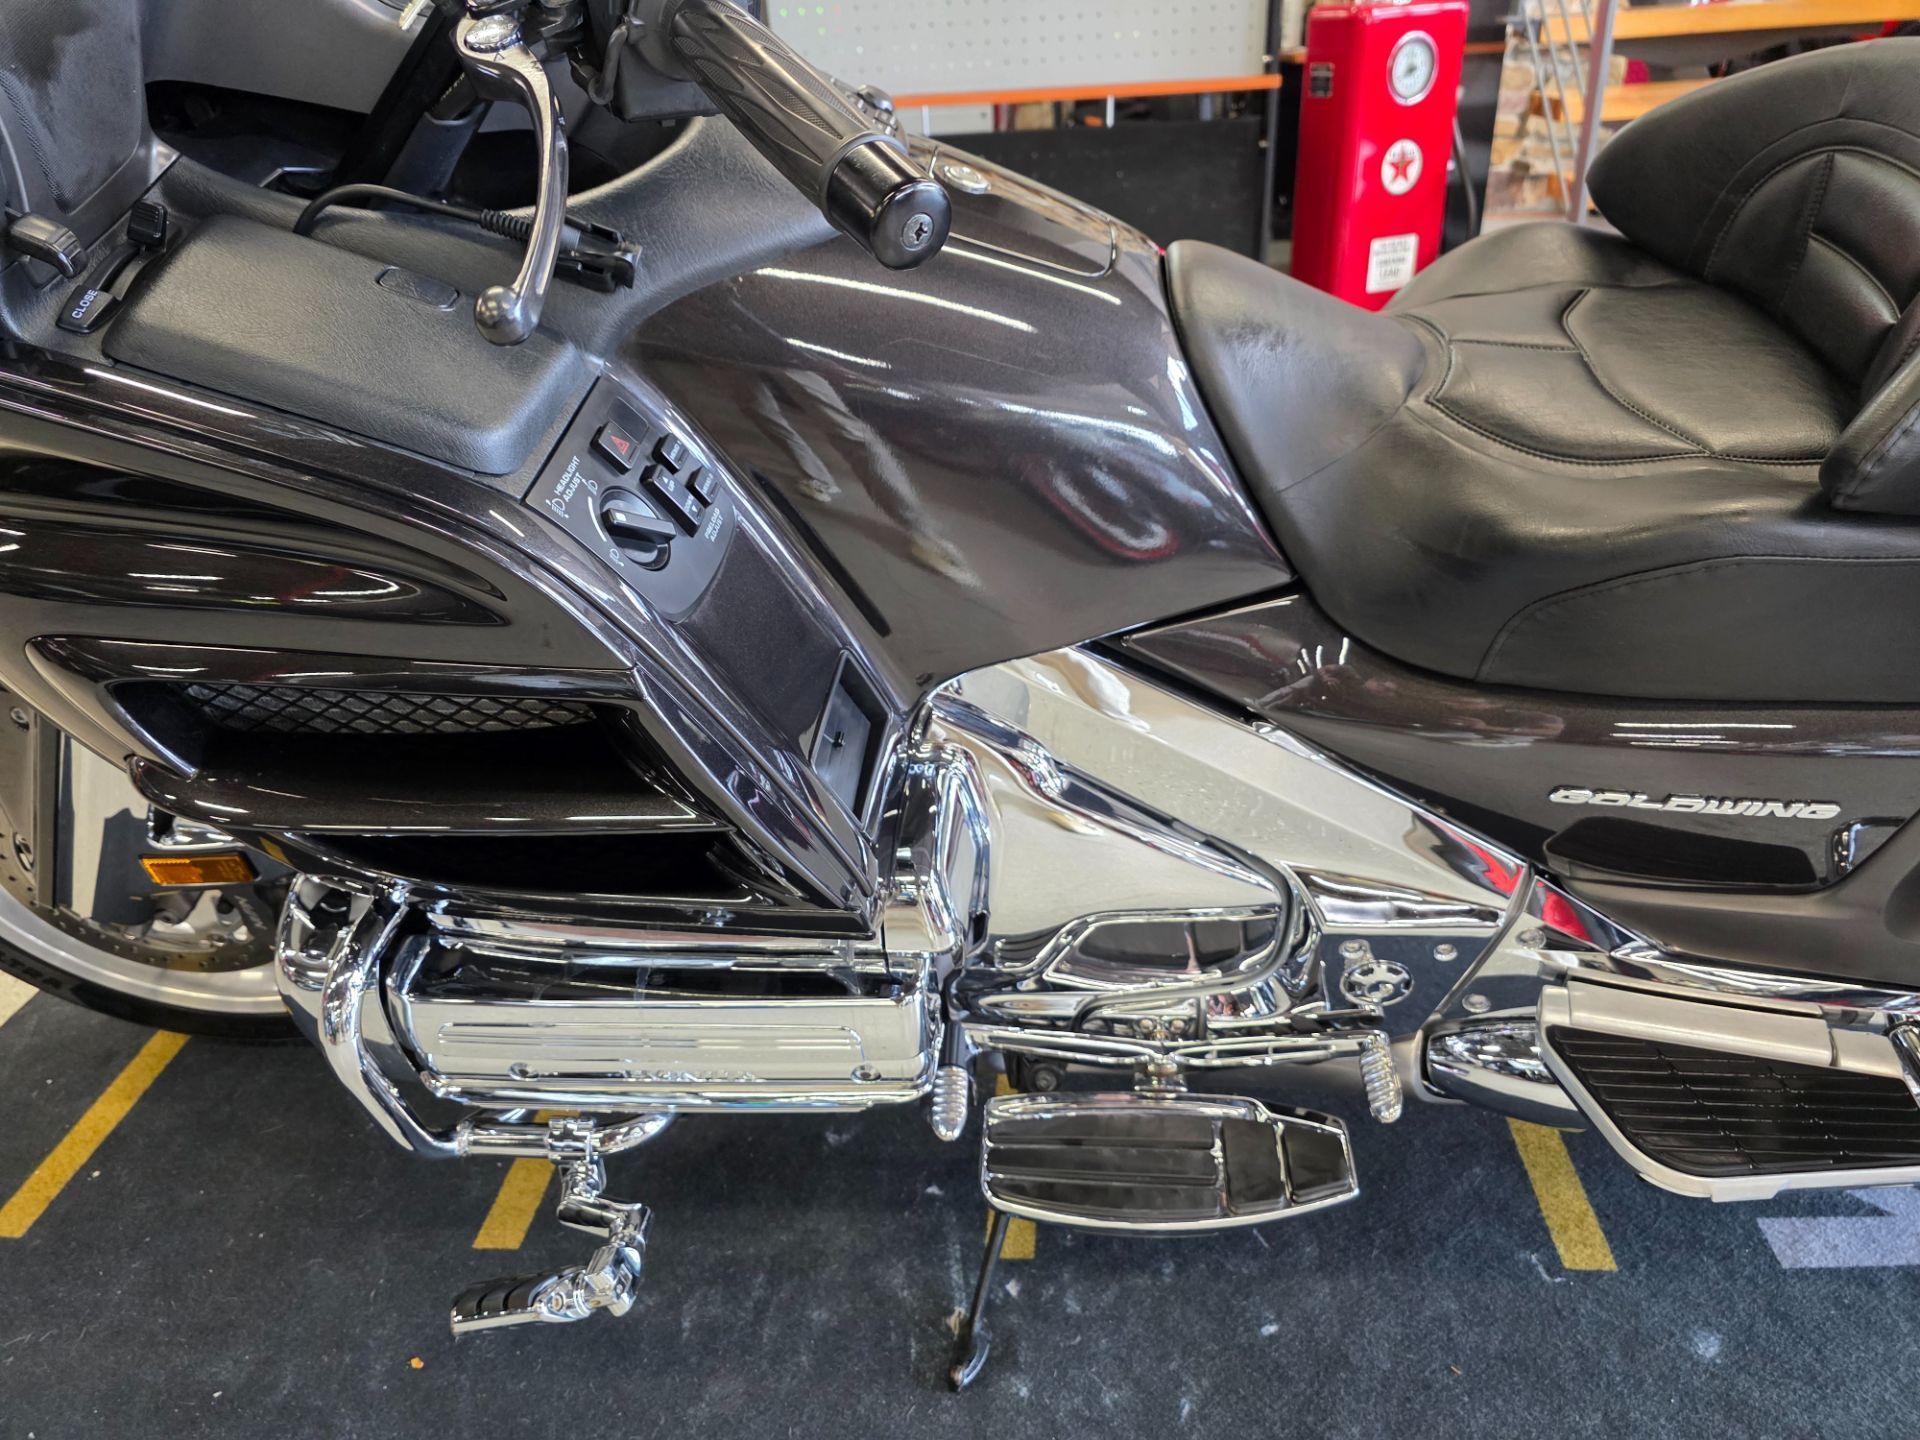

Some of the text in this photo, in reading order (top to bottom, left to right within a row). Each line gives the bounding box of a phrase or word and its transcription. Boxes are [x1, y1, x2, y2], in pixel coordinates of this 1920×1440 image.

[72, 290, 98, 319] CLOSE
[553, 455, 580, 496] HEADLIGHT
[563, 472, 581, 503] ADJUST
[667, 480, 677, 492] UP
[704, 507, 720, 539] PRELOAD
[710, 515, 724, 543] ADJUST
[1549, 788, 1842, 820] GOLDWING
